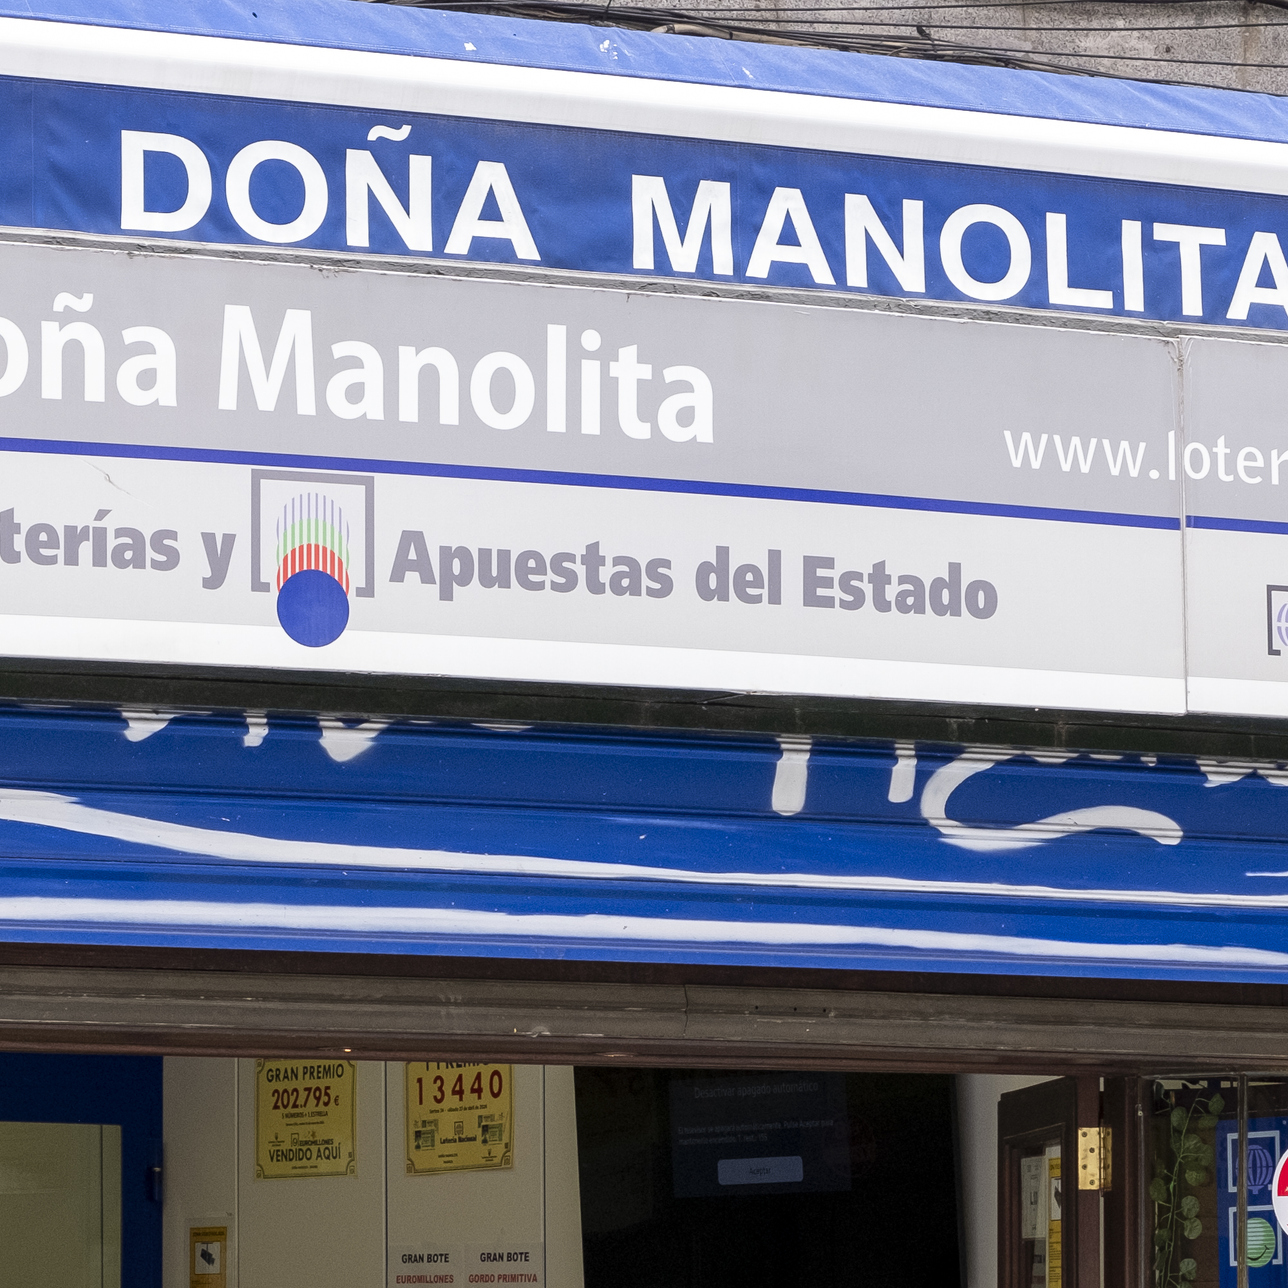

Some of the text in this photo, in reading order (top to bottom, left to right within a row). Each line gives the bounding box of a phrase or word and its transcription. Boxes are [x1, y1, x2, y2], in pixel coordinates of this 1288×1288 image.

[120, 124, 541, 262] DOÑA
[218, 304, 714, 445] Manolita
[200, 532, 237, 591] y
[389, 530, 674, 602] Apuestas
[694, 545, 782, 606] del
[802, 555, 999, 621] Estado
[266, 1063, 345, 1083] GRAN PREMIO
[272, 1085, 340, 1110] 202.795 €
[416, 1069, 503, 1106] 13440
[268, 1143, 342, 1163] VENDIDO AQUÍ
[401, 1253, 450, 1264] GRAN BOTE
[480, 1252, 530, 1263] GRAN BOTE
[396, 1274, 454, 1284] EUROMILLONES
[468, 1273, 538, 1283] GORDO PRIMITIVA
